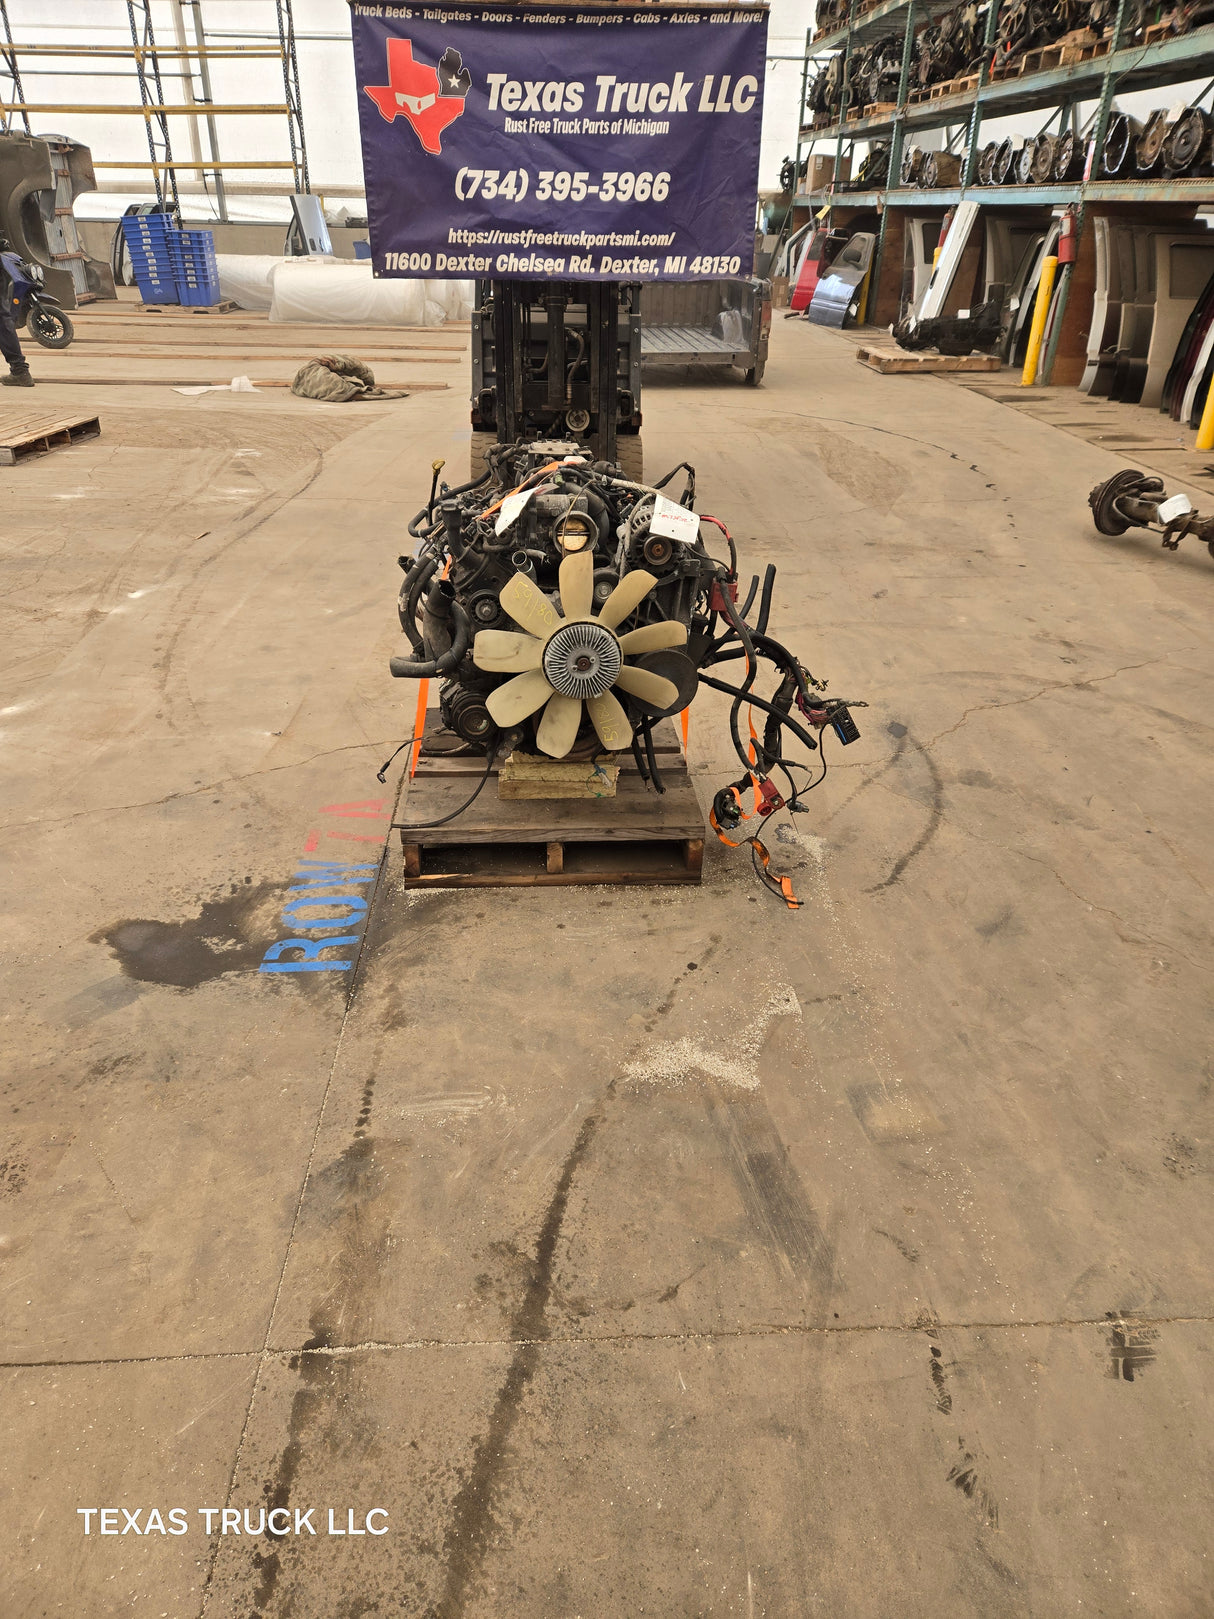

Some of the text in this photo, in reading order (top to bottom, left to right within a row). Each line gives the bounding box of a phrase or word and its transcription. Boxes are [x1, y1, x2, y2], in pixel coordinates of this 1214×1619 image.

[354, 3, 384, 17] Truck
[385, 6, 413, 19] Beds
[423, 9, 472, 23] Tailgates
[482, 12, 513, 22] Doors
[523, 13, 567, 24] Fenders
[576, 14, 624, 26] Bumpers
[633, 13, 661, 24] Cabs
[669, 13, 701, 24] Axles
[710, 12, 731, 24] and
[732, 11, 764, 24] More!
[486, 72, 759, 113] Texas Truck LLC
[504, 117, 670, 137] Rust Free Truck Parts of Michigan
[455, 166, 671, 203] (734) 395-3966
[447, 227, 676, 249] https://rustfreetruckpartsmi.com/
[384, 252, 741, 275] 11600 Dexter Chelsea Rd. Dexter, MI 48130
[258, 859, 379, 973] ROW
